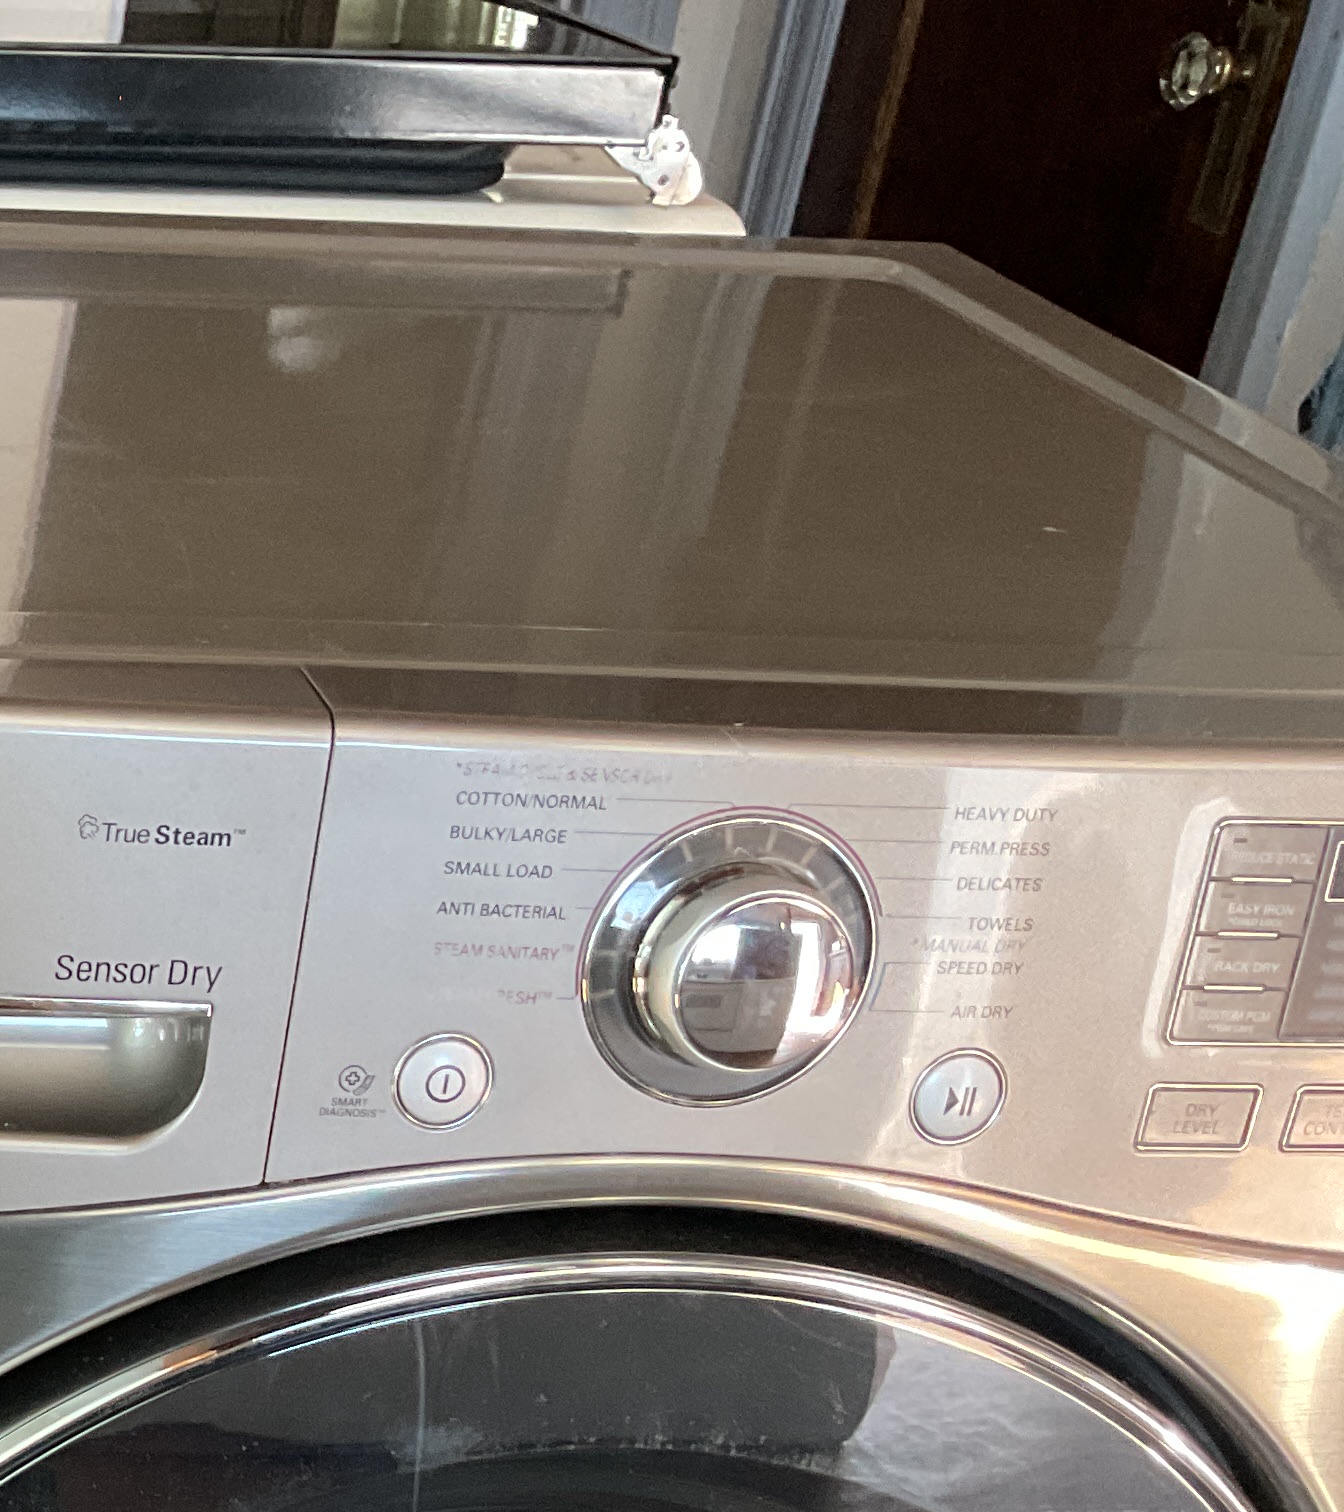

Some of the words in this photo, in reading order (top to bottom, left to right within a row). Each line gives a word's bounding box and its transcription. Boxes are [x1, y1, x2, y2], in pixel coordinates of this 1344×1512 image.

[455, 790, 608, 811] COTTON/NORMAL
[954, 806, 1010, 821] HEAVY
[1012, 807, 1059, 822] DUTY
[449, 825, 569, 845] BULKY/LARGE
[949, 840, 1051, 856] PERM.PRESS
[443, 860, 500, 878] SMALL
[505, 862, 553, 879] LOAD
[956, 876, 1043, 892] DELICATES
[436, 901, 475, 917] ANTI
[480, 903, 567, 921] BACTERIAL
[1228, 903, 1259, 916] EASY
[1263, 903, 1296, 916] IRON
[968, 916, 1035, 932] TOWELS
[434, 941, 483, 957] STEAM
[54, 953, 160, 986] Sensor
[167, 957, 223, 993] Dry
[936, 960, 988, 976] SPEED
[991, 961, 1025, 976] DRY
[1214, 961, 1249, 973] RACK
[1252, 961, 1281, 974] DRY
[950, 1005, 977, 1019] AIR
[981, 1005, 1014, 1020] DRY
[331, 1097, 368, 1107] SMART
[1185, 1102, 1220, 1117] DRY
[1172, 1119, 1220, 1135] LEVEL
